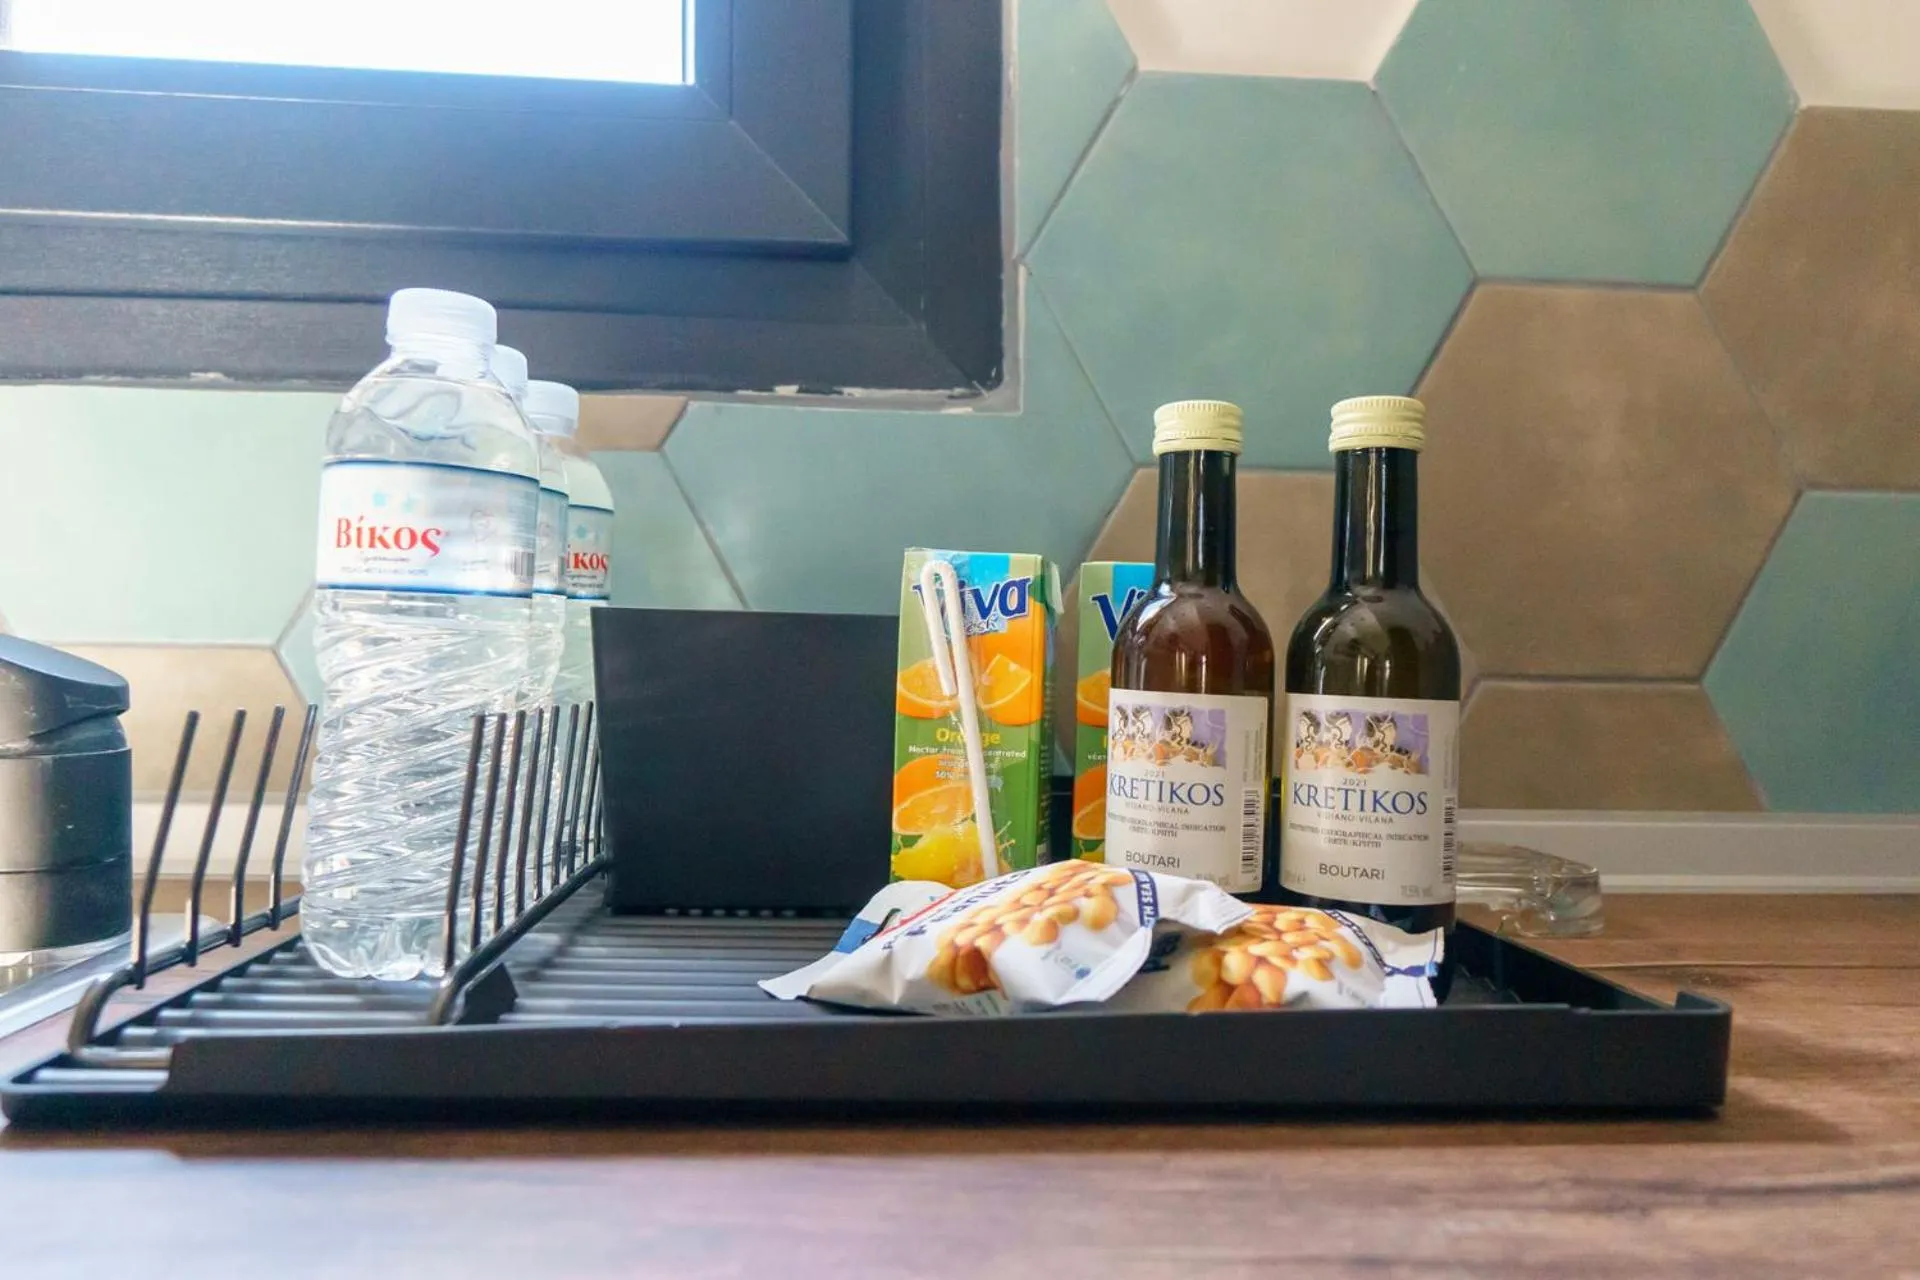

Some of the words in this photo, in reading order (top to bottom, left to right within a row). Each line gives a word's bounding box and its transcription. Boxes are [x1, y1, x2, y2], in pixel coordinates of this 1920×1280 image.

[566, 544, 609, 576] ίκος
[936, 728, 1001, 747] Orge
[1109, 772, 1225, 807] KRETIKOS
[1342, 778, 1367, 787] 2021
[1293, 781, 1428, 815] KRETIKOS
[1126, 851, 1180, 868] BOUTARI
[1319, 863, 1385, 880] BOUTARI
